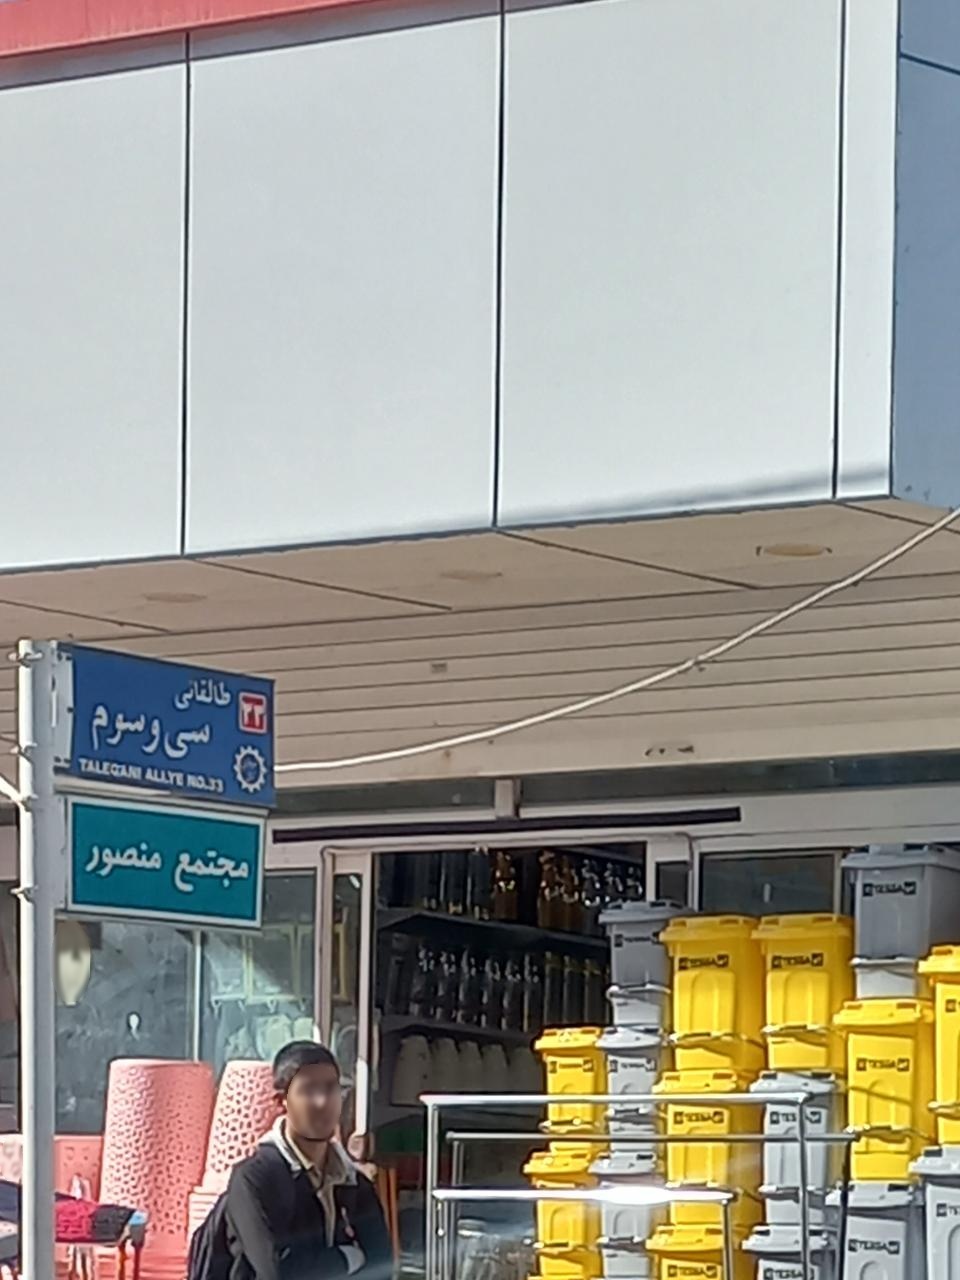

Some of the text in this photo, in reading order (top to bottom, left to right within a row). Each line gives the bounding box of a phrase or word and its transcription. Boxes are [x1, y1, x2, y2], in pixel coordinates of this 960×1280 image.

[175, 679, 231, 710] طالقانی
[91, 704, 210, 758] سی و سوم
[85, 842, 249, 892] مجتمع منصور
